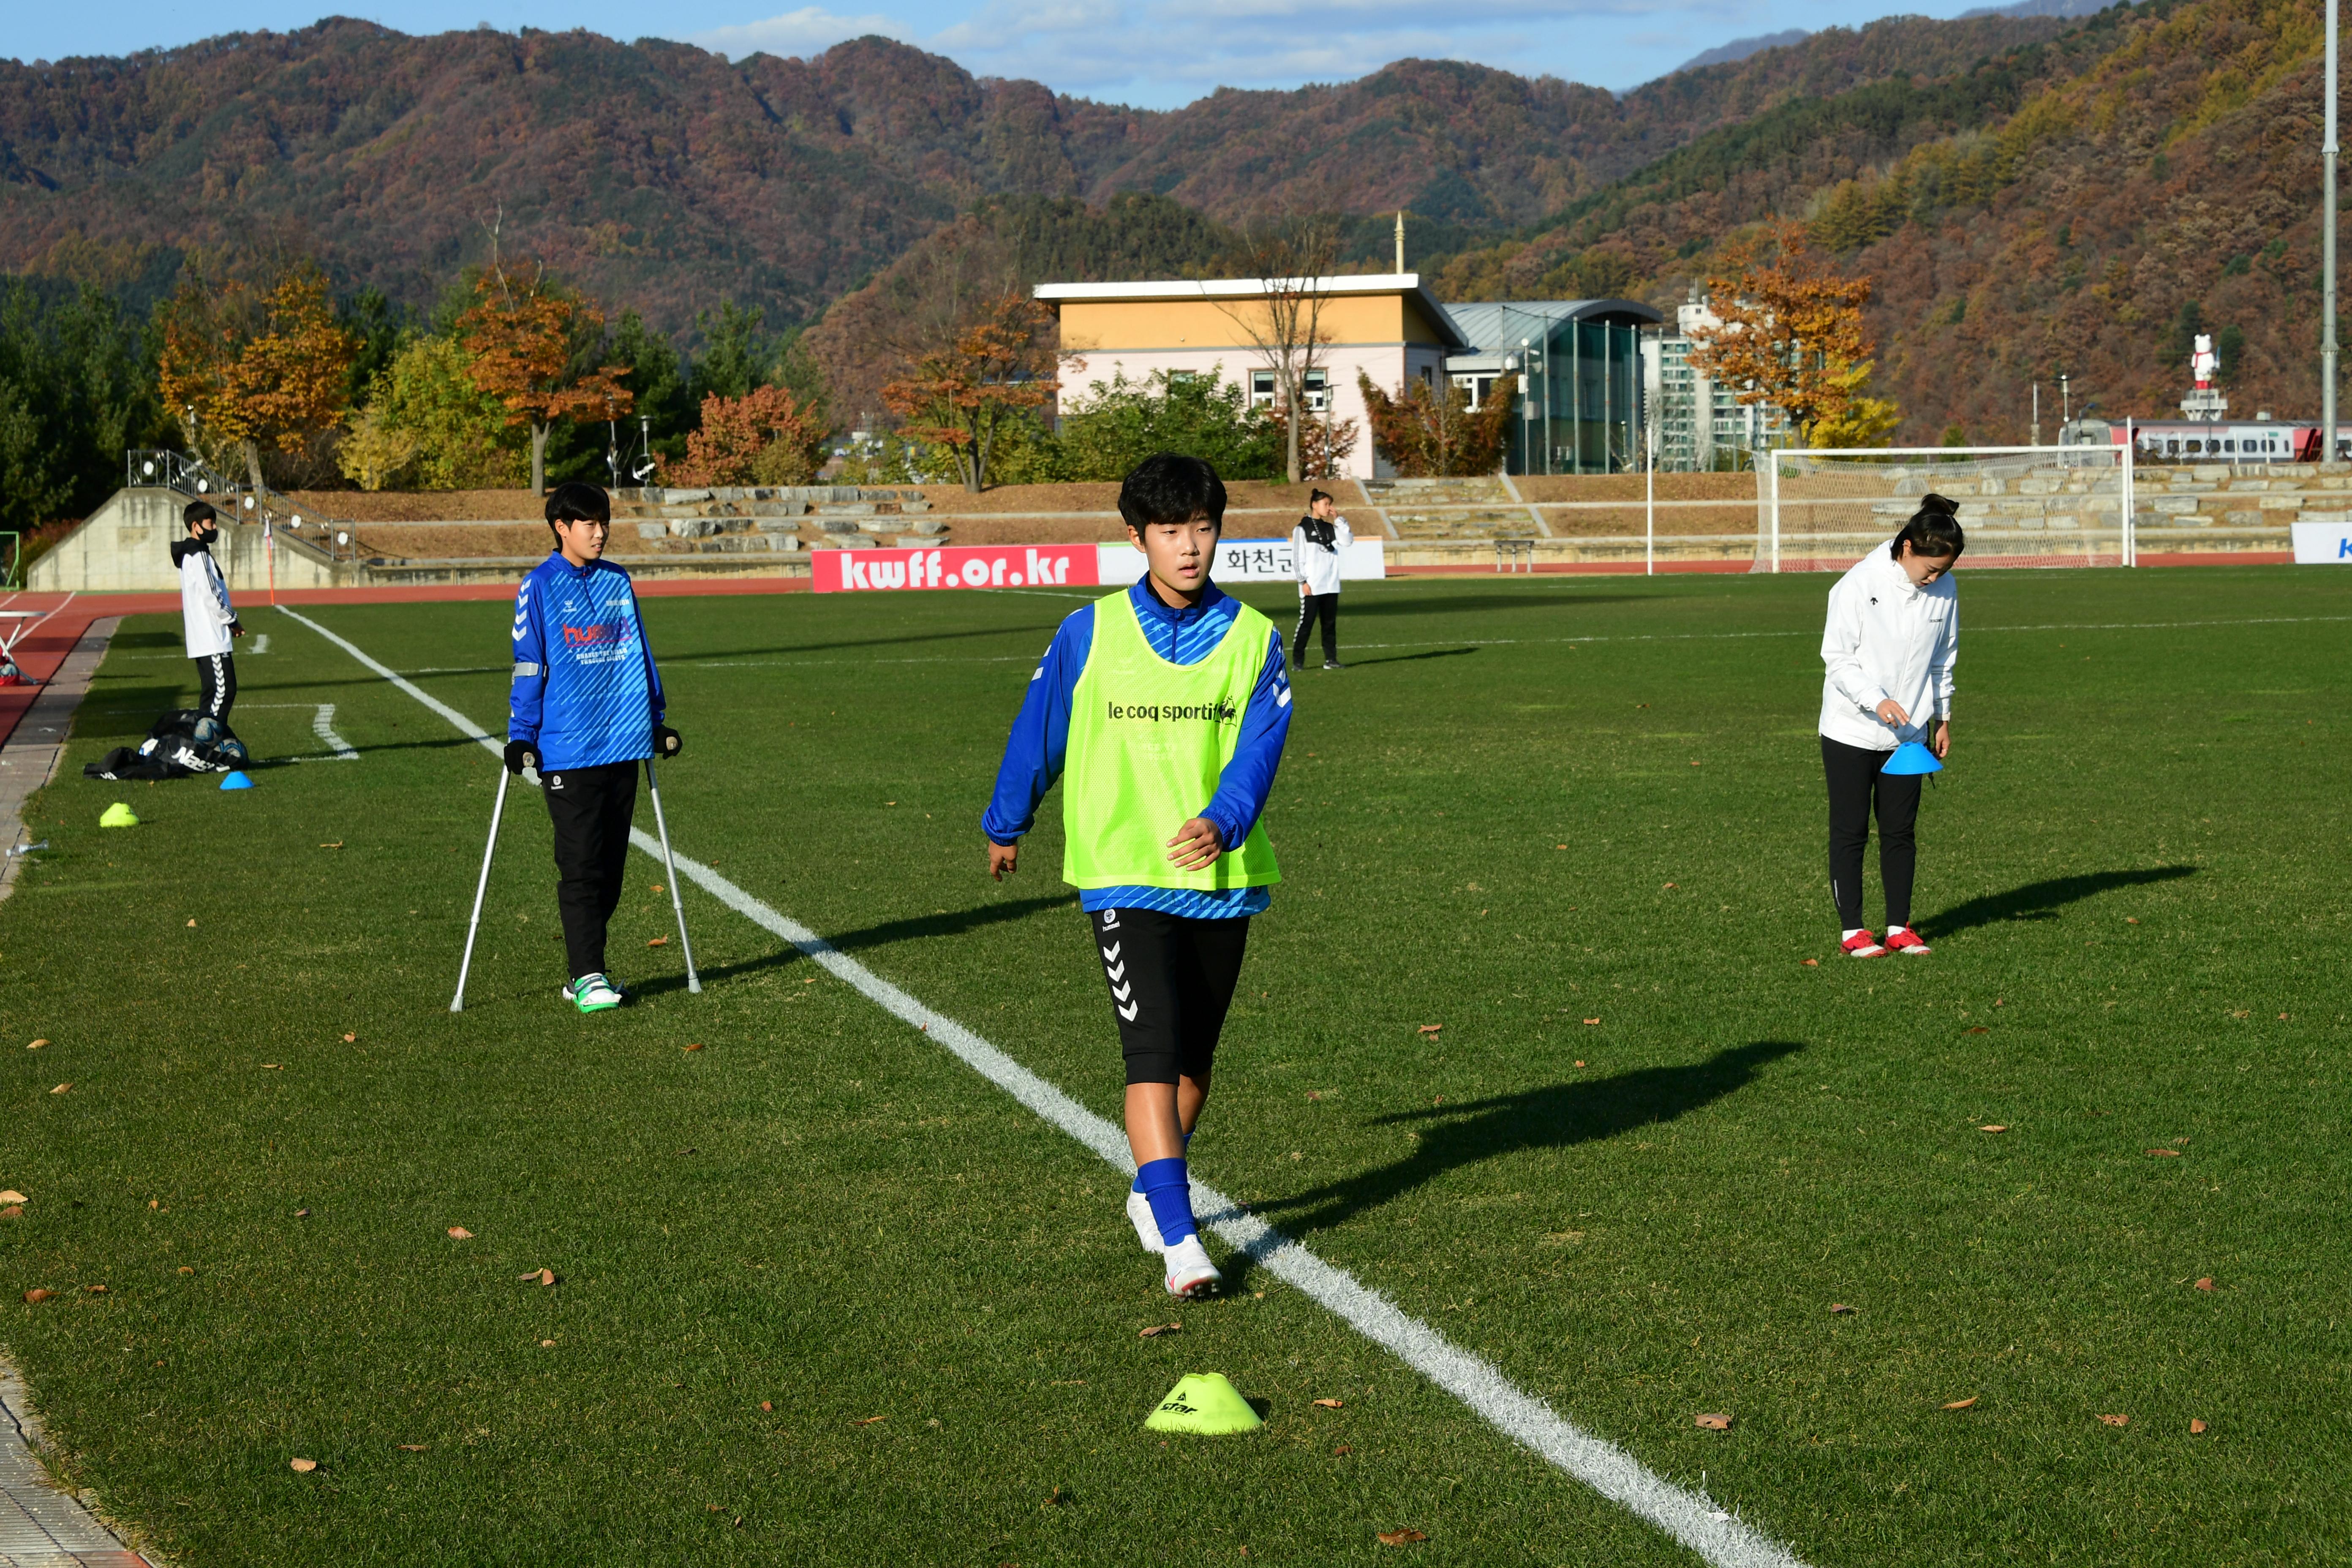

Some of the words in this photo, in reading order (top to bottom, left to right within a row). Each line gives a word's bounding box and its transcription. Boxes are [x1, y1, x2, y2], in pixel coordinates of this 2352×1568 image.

[840, 549, 1070, 589] kwff.or.kr
[1108, 701, 1123, 719] le
[1127, 705, 1158, 721] coq
[1160, 1402, 1198, 1414] star
